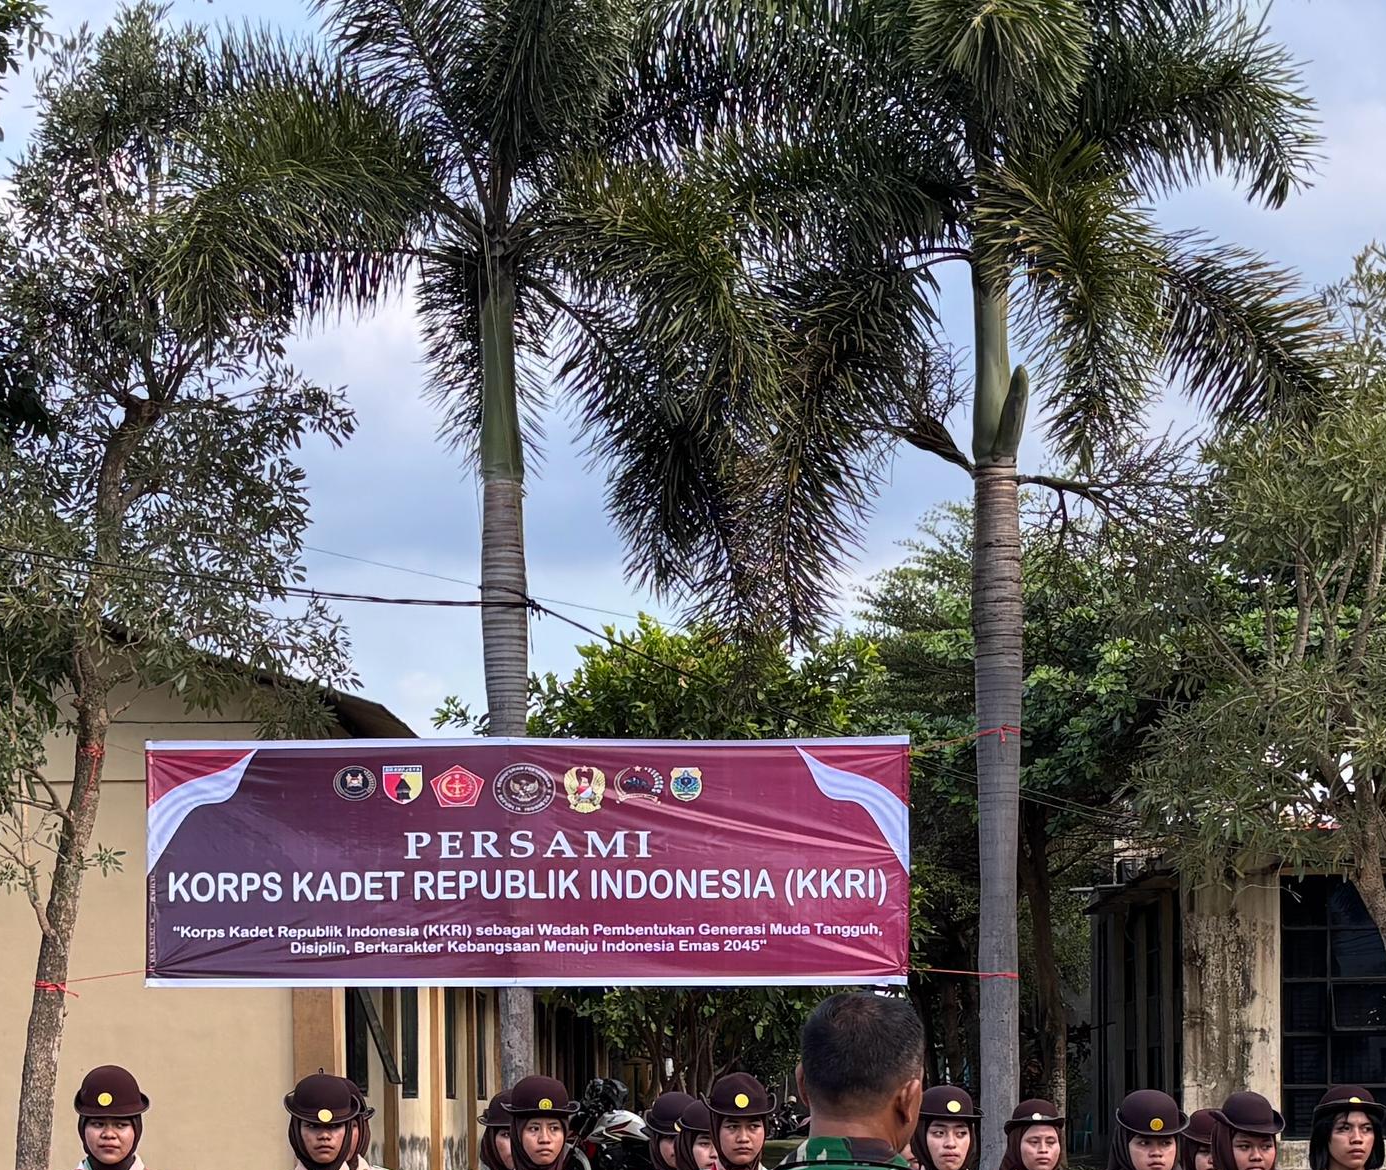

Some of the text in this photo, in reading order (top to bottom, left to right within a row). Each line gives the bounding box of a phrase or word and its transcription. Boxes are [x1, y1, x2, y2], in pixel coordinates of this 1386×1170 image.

[403, 830, 652, 859] PERSAMI
[168, 868, 887, 906] KORPS KADET REPUBLIK INDONESIA (KKRI)
[229, 925, 275, 938] Kadet
[277, 925, 343, 941] Republik
[346, 925, 420, 938] Indonesia
[422, 924, 472, 940] (KKRI)
[475, 924, 534, 940] sebagai
[537, 923, 589, 936] Wadah
[593, 923, 695, 937] Pembentukan
[697, 922, 767, 936] Generasi
[769, 922, 811, 936] Muda
[813, 922, 883, 938] Tangguh,
[289, 941, 351, 957] Disiplin,
[353, 941, 443, 954] Berkarakter
[447, 940, 541, 955] Kebangsaan
[544, 939, 598, 955] Menuju
[602, 939, 675, 952] Indonesia
[678, 939, 720, 952] Emas
